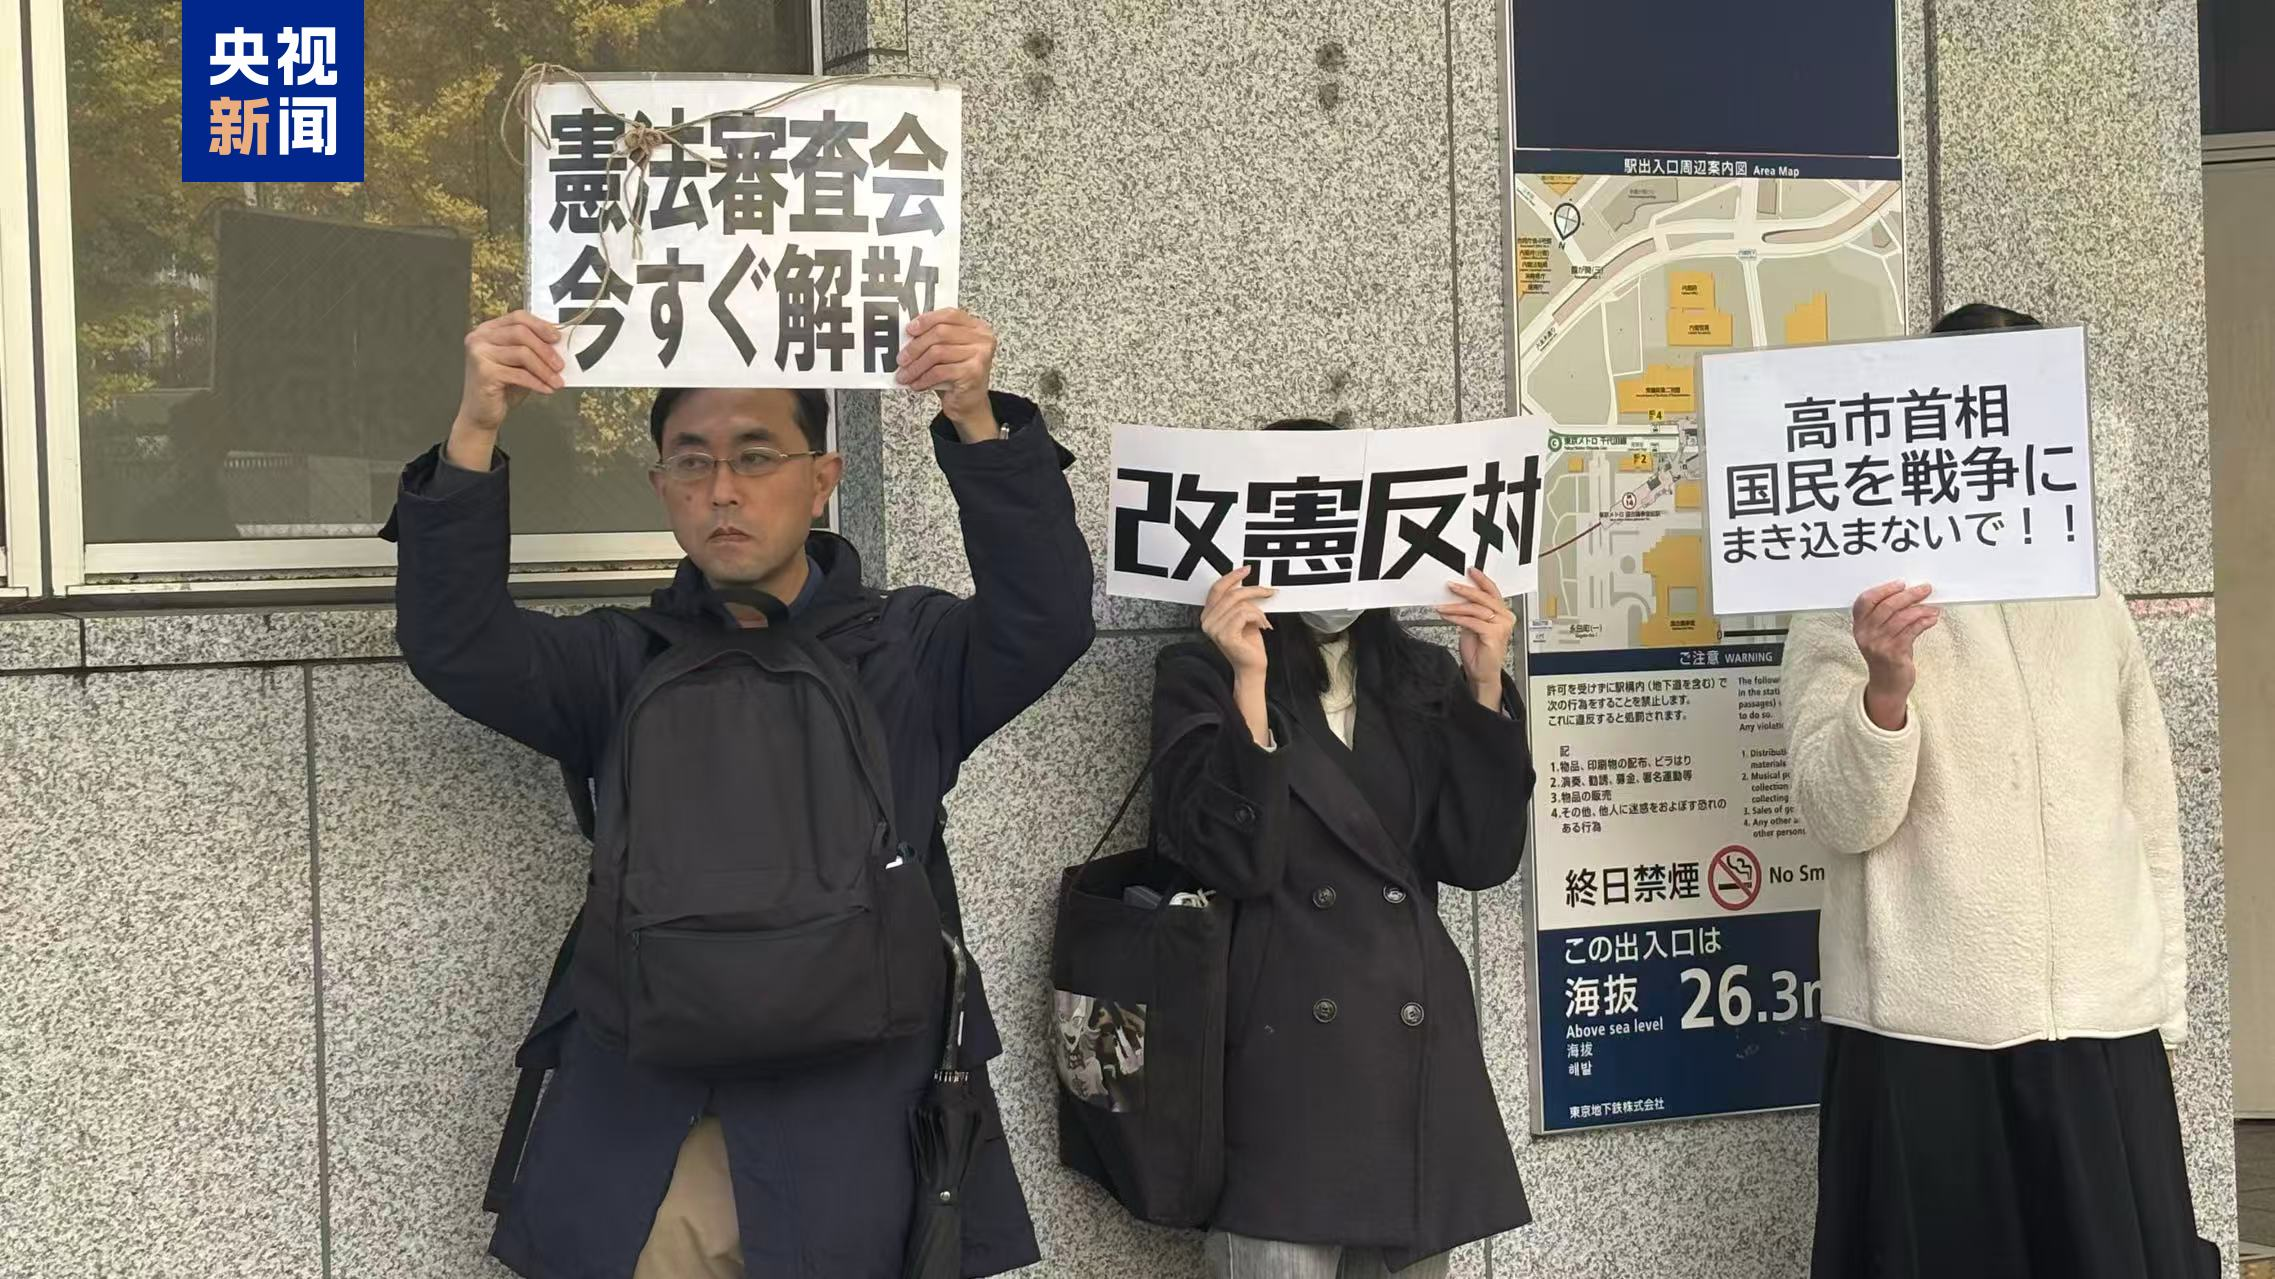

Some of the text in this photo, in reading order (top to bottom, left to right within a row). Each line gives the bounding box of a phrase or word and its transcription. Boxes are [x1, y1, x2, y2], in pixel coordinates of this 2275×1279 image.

[549, 107, 949, 236] 憲法審査会
[1624, 158, 1800, 178] 駅出入口周辺案内図 Area Map
[549, 243, 939, 373] 今すぐ解散
[1656, 411, 1662, 420] 4
[1784, 384, 2010, 452] 高市首相
[1641, 455, 1647, 464] 2
[1726, 444, 2077, 519] 国民を戦争に
[1114, 455, 1542, 586] 改憲反対
[1722, 504, 2076, 564] まき込まないで！！
[1679, 650, 1773, 666] ご注意 WARNING
[1738, 677, 1752, 685] The
[1738, 688, 1746, 696] in
[1748, 688, 1761, 696] the
[1738, 698, 1776, 710] passages)
[1739, 711, 1747, 720] to
[1749, 711, 1760, 719] do
[1740, 723, 1755, 732] Any
[1560, 745, 1570, 757] 記
[1750, 760, 1786, 769] materials
[1742, 772, 1748, 781] 2.
[1751, 770, 1780, 780] Musical
[1751, 782, 1788, 791] collection
[1752, 795, 1789, 803] collecting
[1752, 806, 1772, 814] Sales
[1774, 805, 1782, 813] of
[1562, 821, 1602, 834] ある行為
[1753, 818, 1768, 828] Any
[1770, 817, 1791, 825] other
[1753, 829, 1774, 838] other
[1565, 861, 1825, 908] 終日禁煙 No Sm
[1564, 926, 1722, 965] この出入口は
[1565, 973, 1639, 1018] 海抜
[1566, 1016, 1664, 1039] Above sea level
[1568, 1060, 1592, 1076] 해발
[1569, 1097, 1665, 1119] 東京地下鉄株式会社
